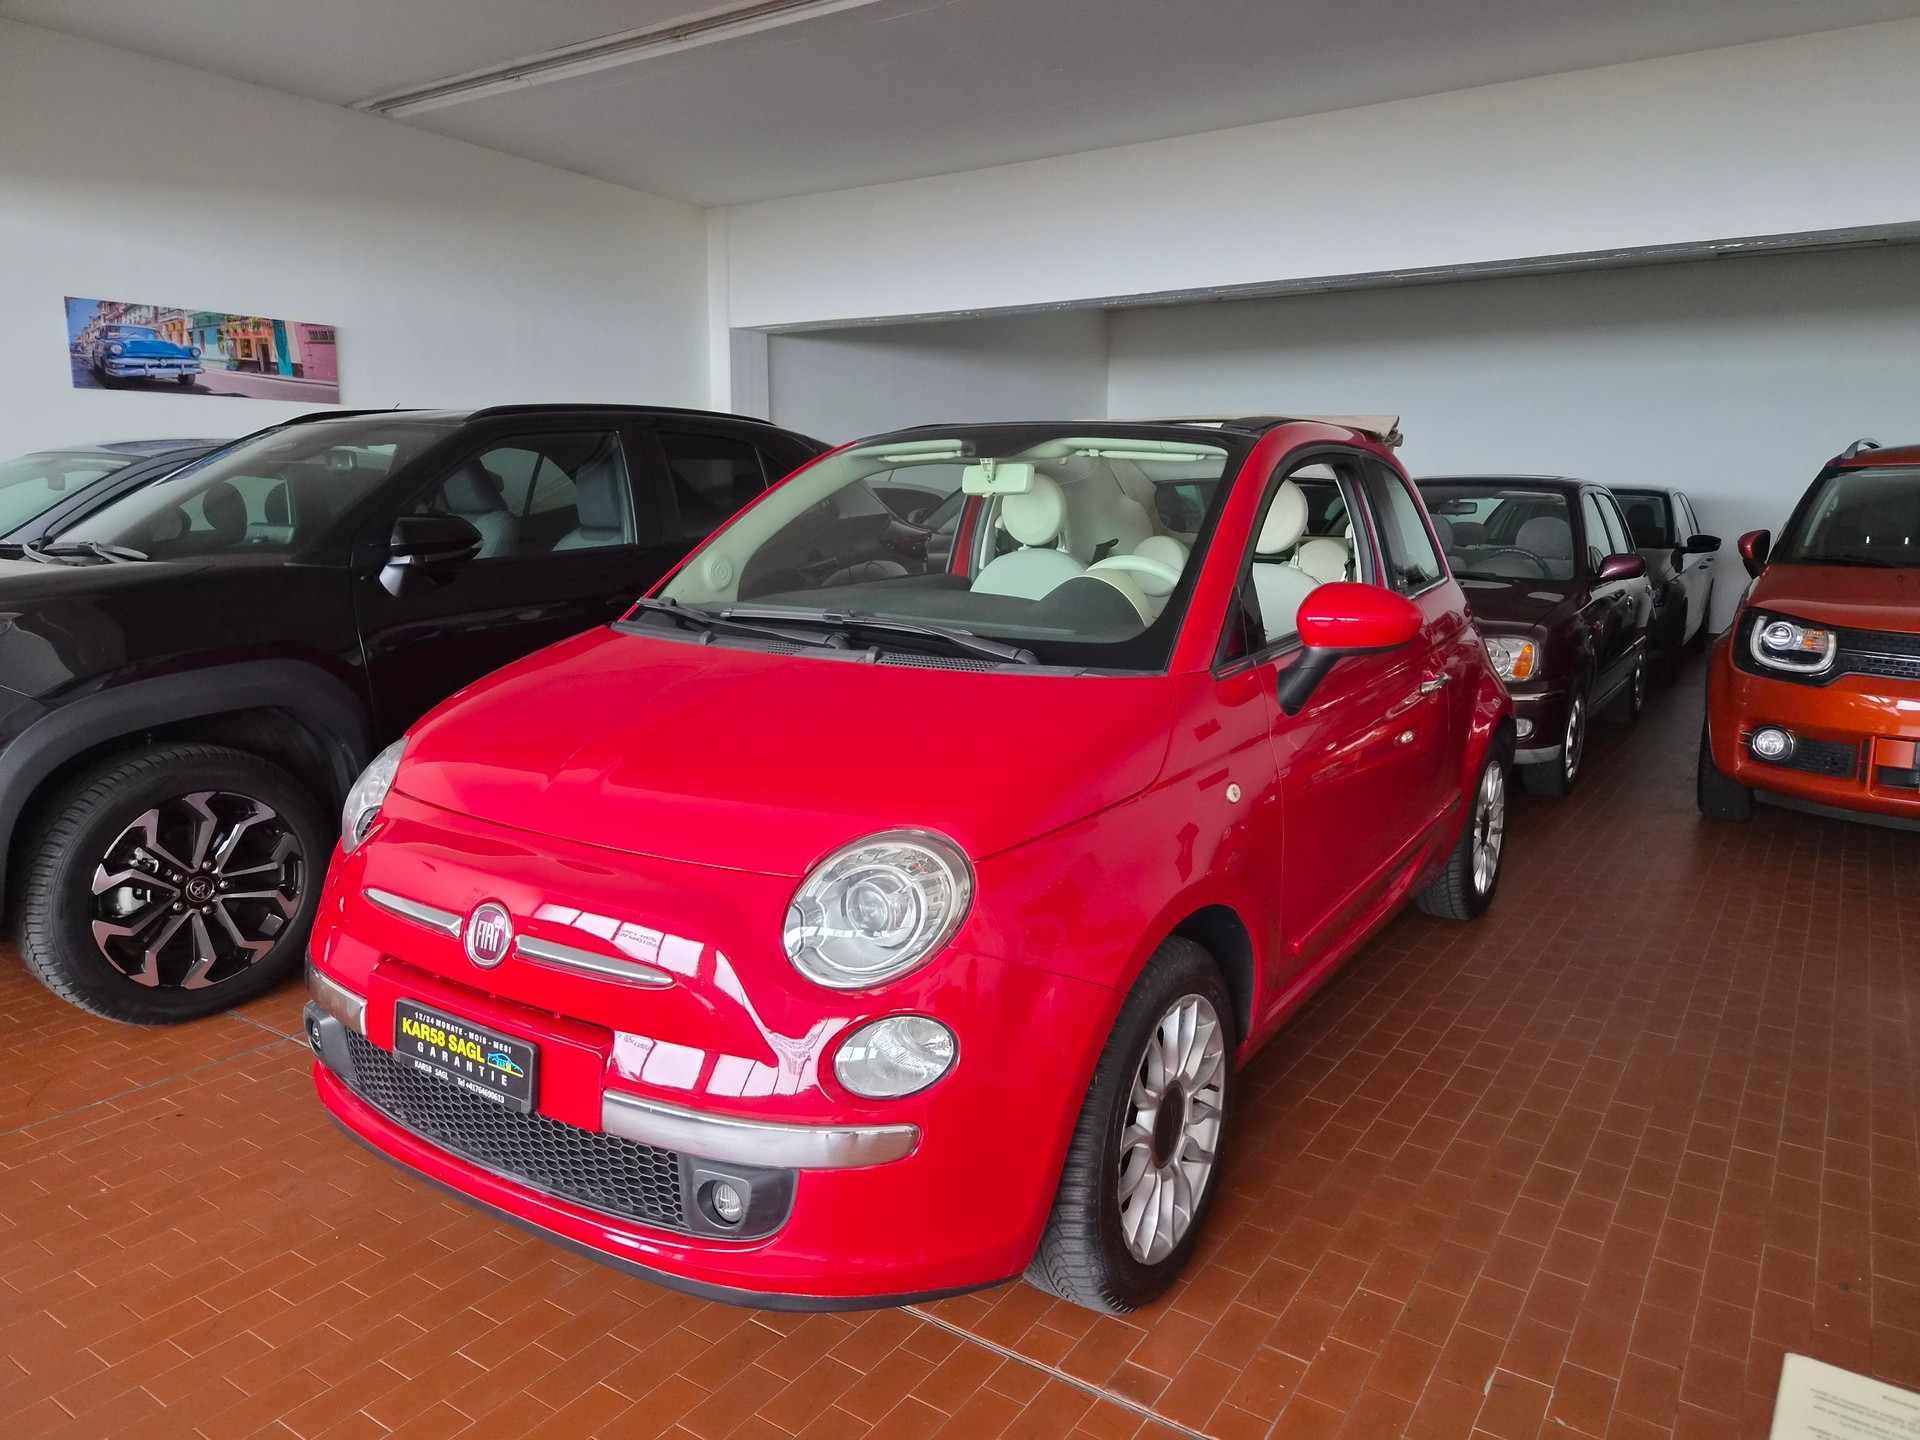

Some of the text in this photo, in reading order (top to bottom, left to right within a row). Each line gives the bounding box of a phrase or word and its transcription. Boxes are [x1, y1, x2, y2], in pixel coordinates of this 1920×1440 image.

[475, 920, 503, 952] FIAT
[402, 1016, 486, 1064] KAR58 SAGL
[414, 1011, 434, 1025] 12/24
[435, 1018, 463, 1036] MONATE
[468, 1031, 487, 1045] MOIS
[493, 1040, 512, 1054] MESI
[414, 1060, 432, 1074] KAR58
[434, 1068, 449, 1081] SAGL
[417, 1041, 508, 1087] GARANTIE
